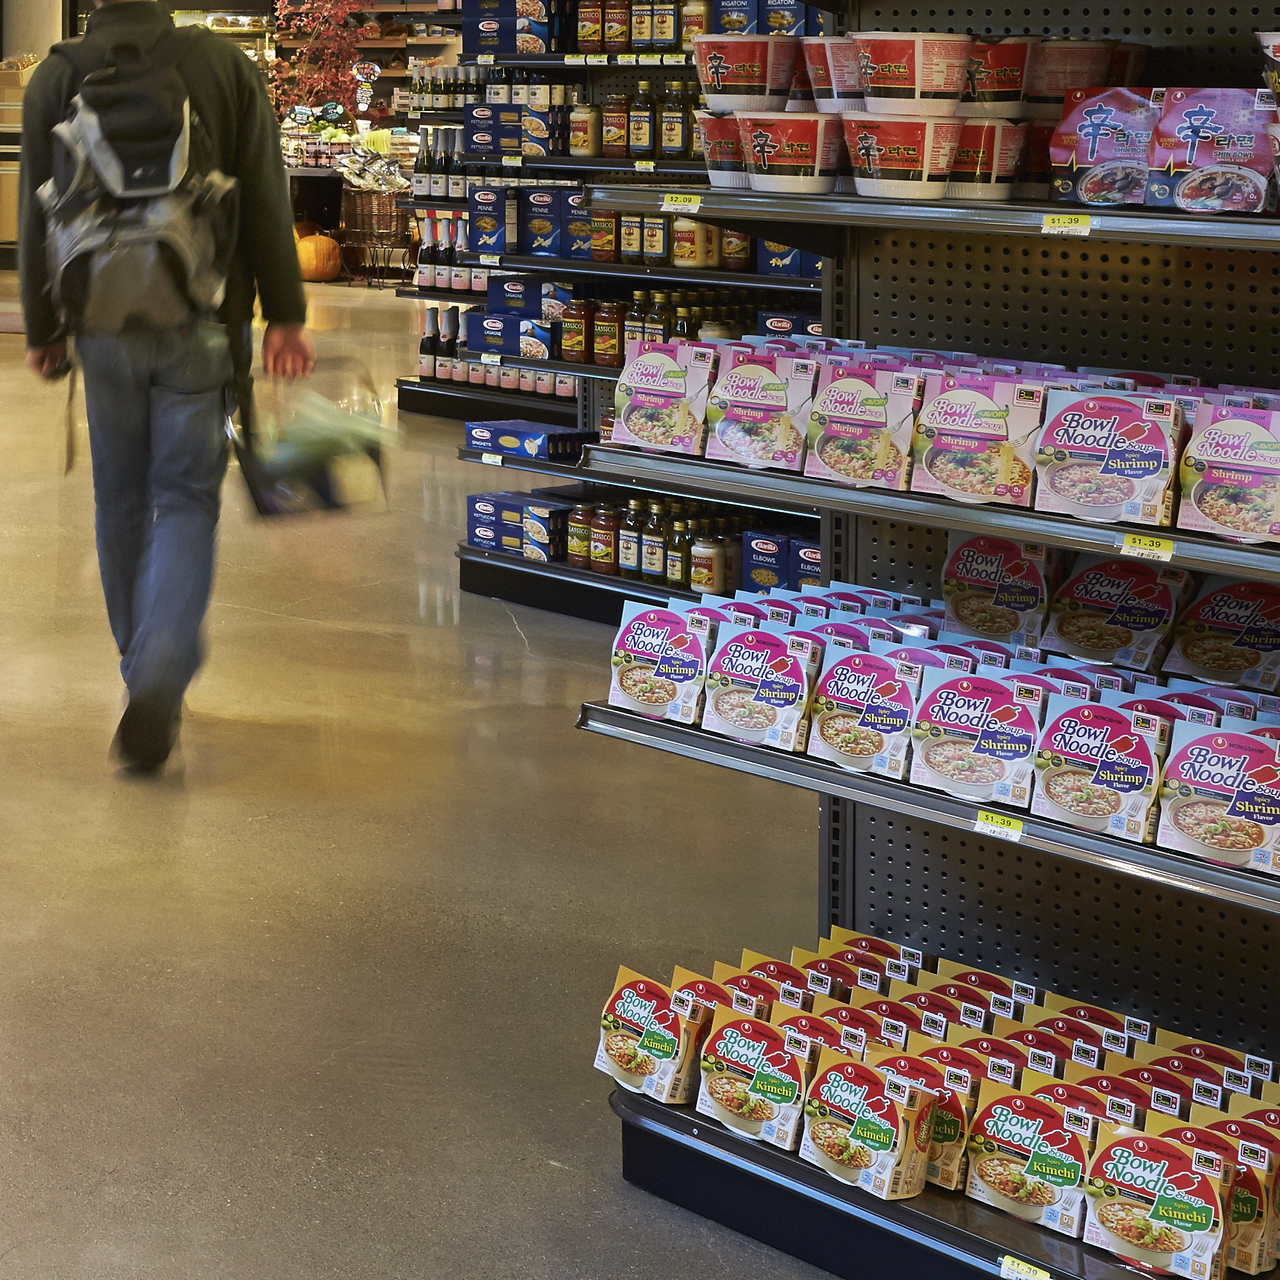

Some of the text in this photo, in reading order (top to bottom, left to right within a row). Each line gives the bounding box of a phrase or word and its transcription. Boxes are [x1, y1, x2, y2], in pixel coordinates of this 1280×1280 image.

[933, 397, 976, 418] Bowl
[927, 410, 982, 430] Noodle
[1061, 411, 1118, 434] Bowl
[941, 435, 978, 449] Shrimp
[1055, 428, 1127, 451] Noodle
[1108, 458, 1158, 471] Shrimp
[1131, 538, 1162, 549] $1.39
[752, 554, 776, 564] ELBOWS
[938, 690, 990, 713] Bowl
[930, 706, 998, 732] Noodle
[1059, 718, 1110, 744] Bowl
[980, 739, 1028, 753] Shrimp
[1052, 733, 1116, 763] Noodle
[1098, 769, 1143, 785] Shrimp
[984, 814, 1012, 827] $1.39
[990, 1104, 1044, 1136] Bowl
[985, 1118, 1049, 1154] Noodle
[1032, 1163, 1076, 1181] Kimchi
[1111, 1146, 1169, 1178] Bowl
[1103, 1160, 1176, 1199] Noodle
[1157, 1208, 1207, 1225] Kimchi
